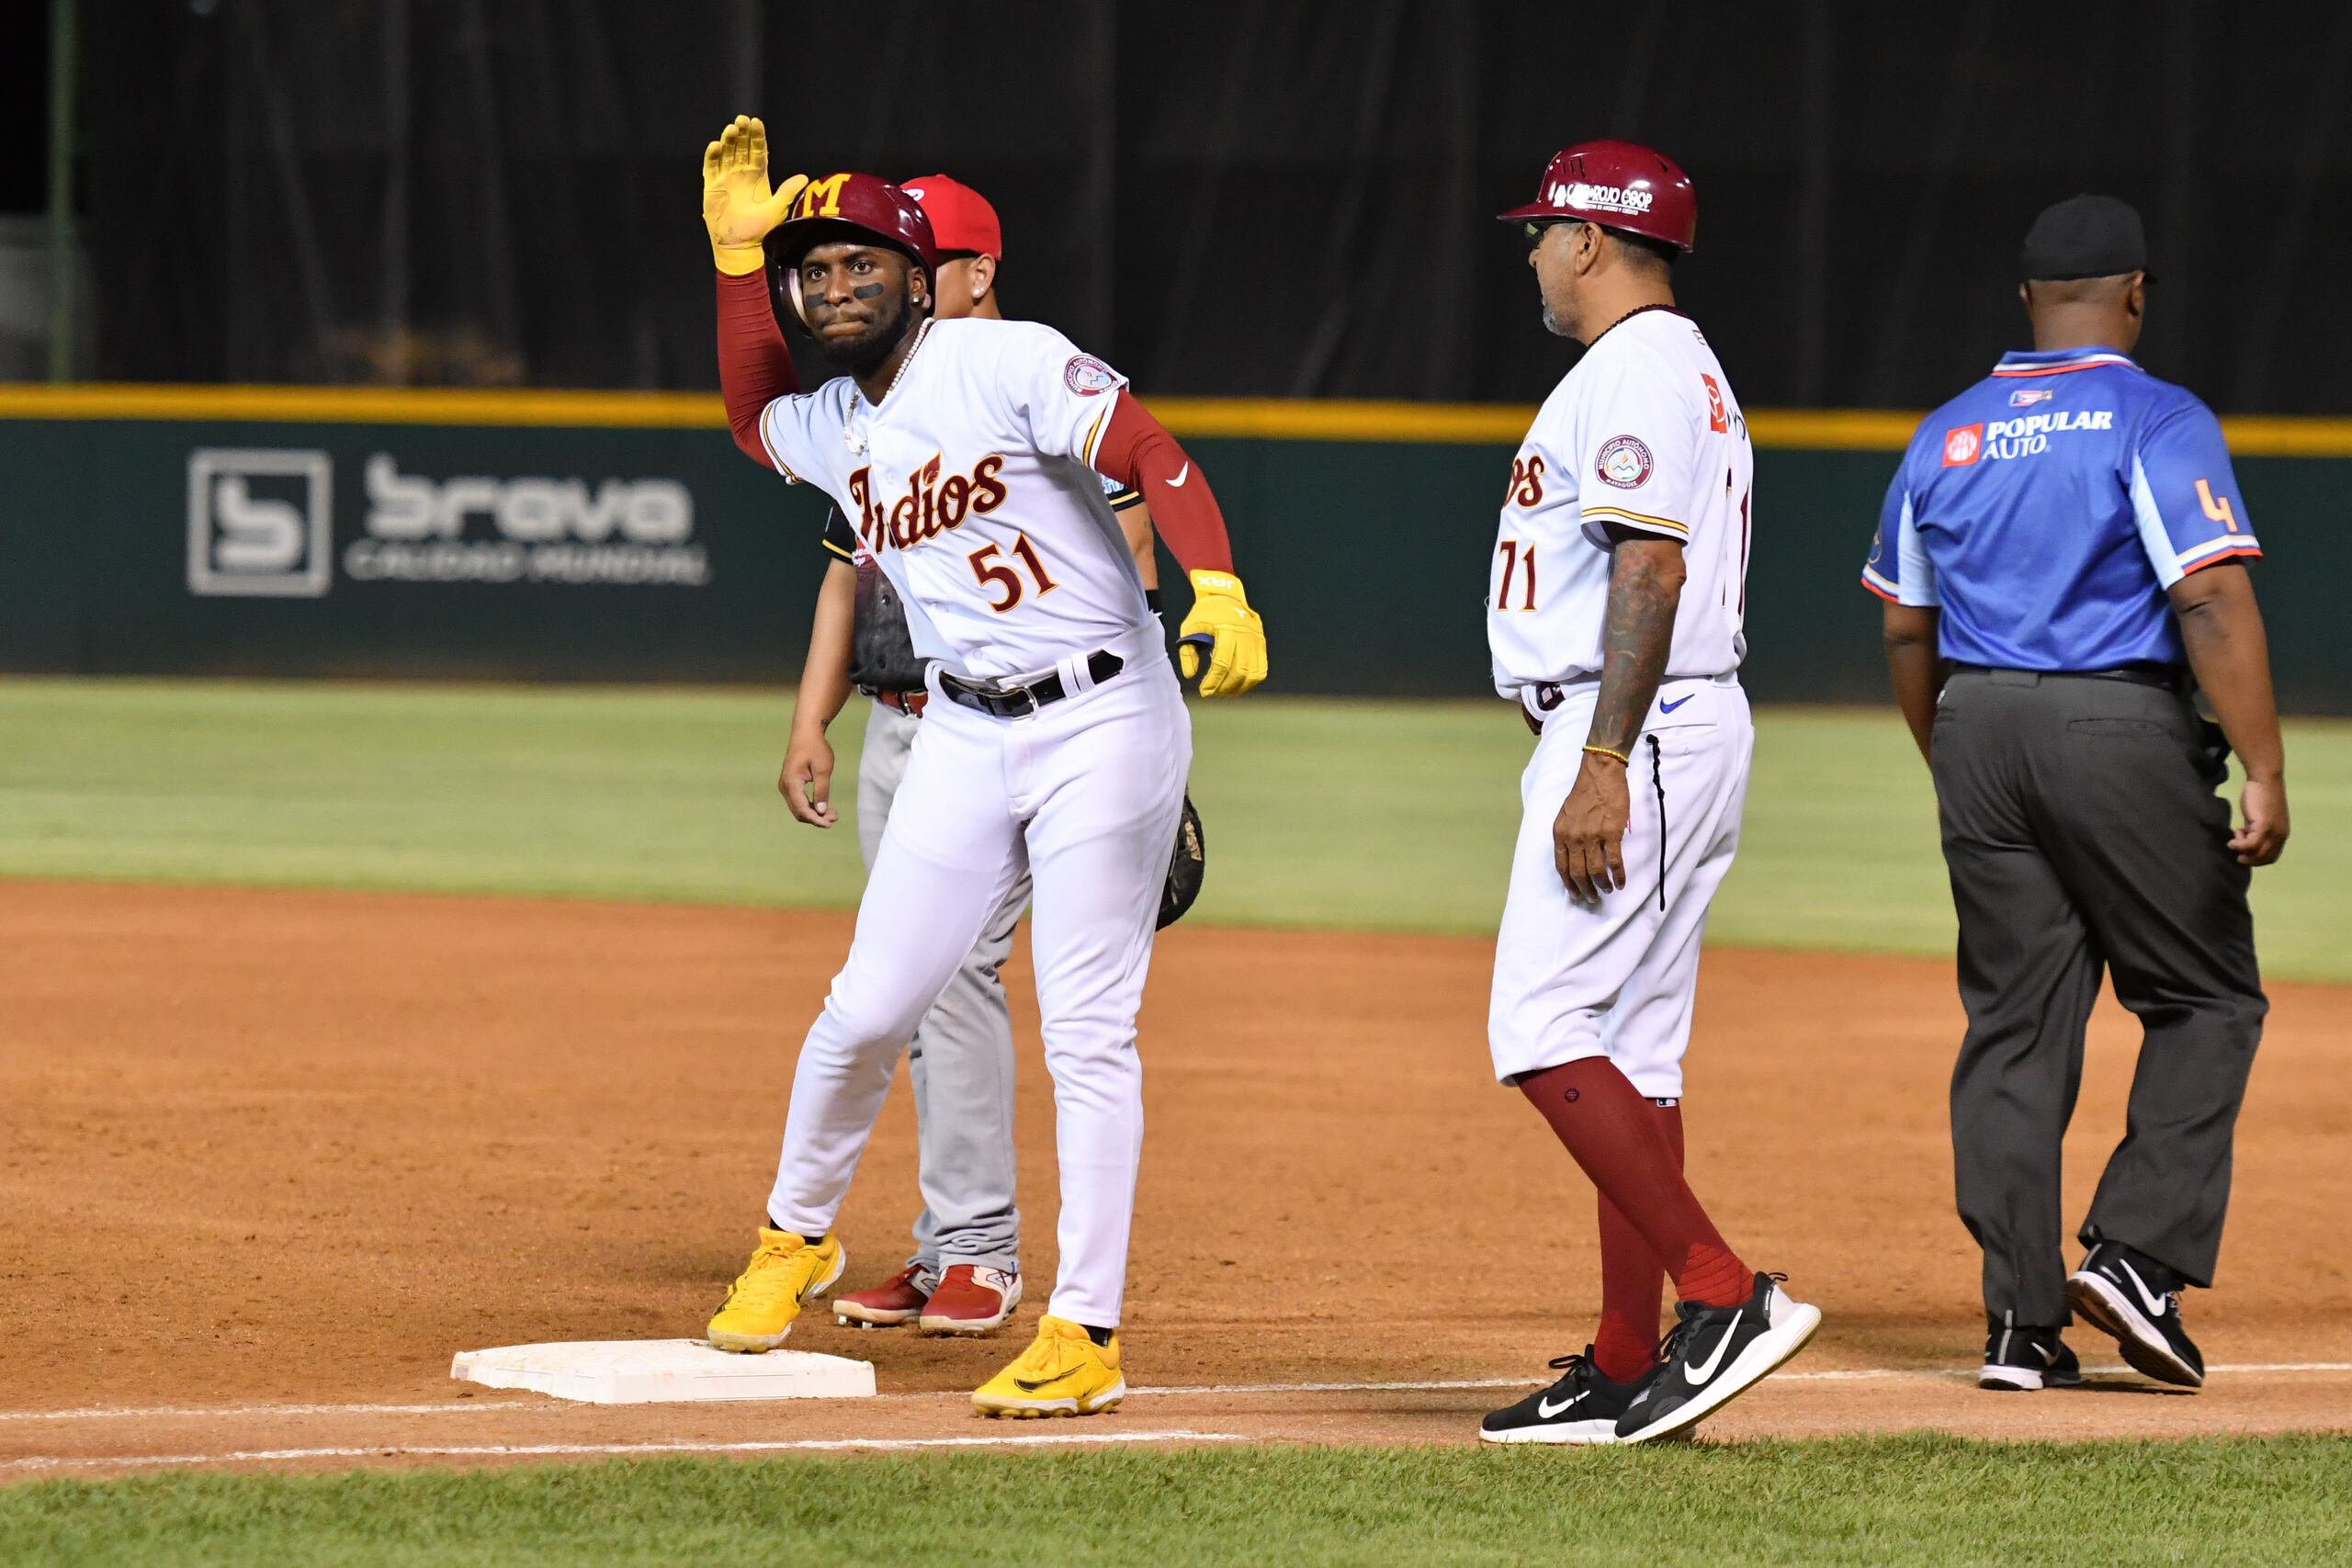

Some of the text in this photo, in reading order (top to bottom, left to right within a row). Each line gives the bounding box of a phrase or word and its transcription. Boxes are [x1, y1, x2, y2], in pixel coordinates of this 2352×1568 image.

[802, 174, 852, 218] M
[1592, 185, 1621, 203] ROJO
[1621, 188, 1653, 209] COOP
[1985, 411, 2113, 442] POPULAR
[1598, 441, 1622, 469] MUNICIPIO
[848, 449, 1007, 555] Indios
[2194, 478, 2238, 533] 4
[967, 529, 1058, 614] 51
[1496, 540, 1538, 612] 71
